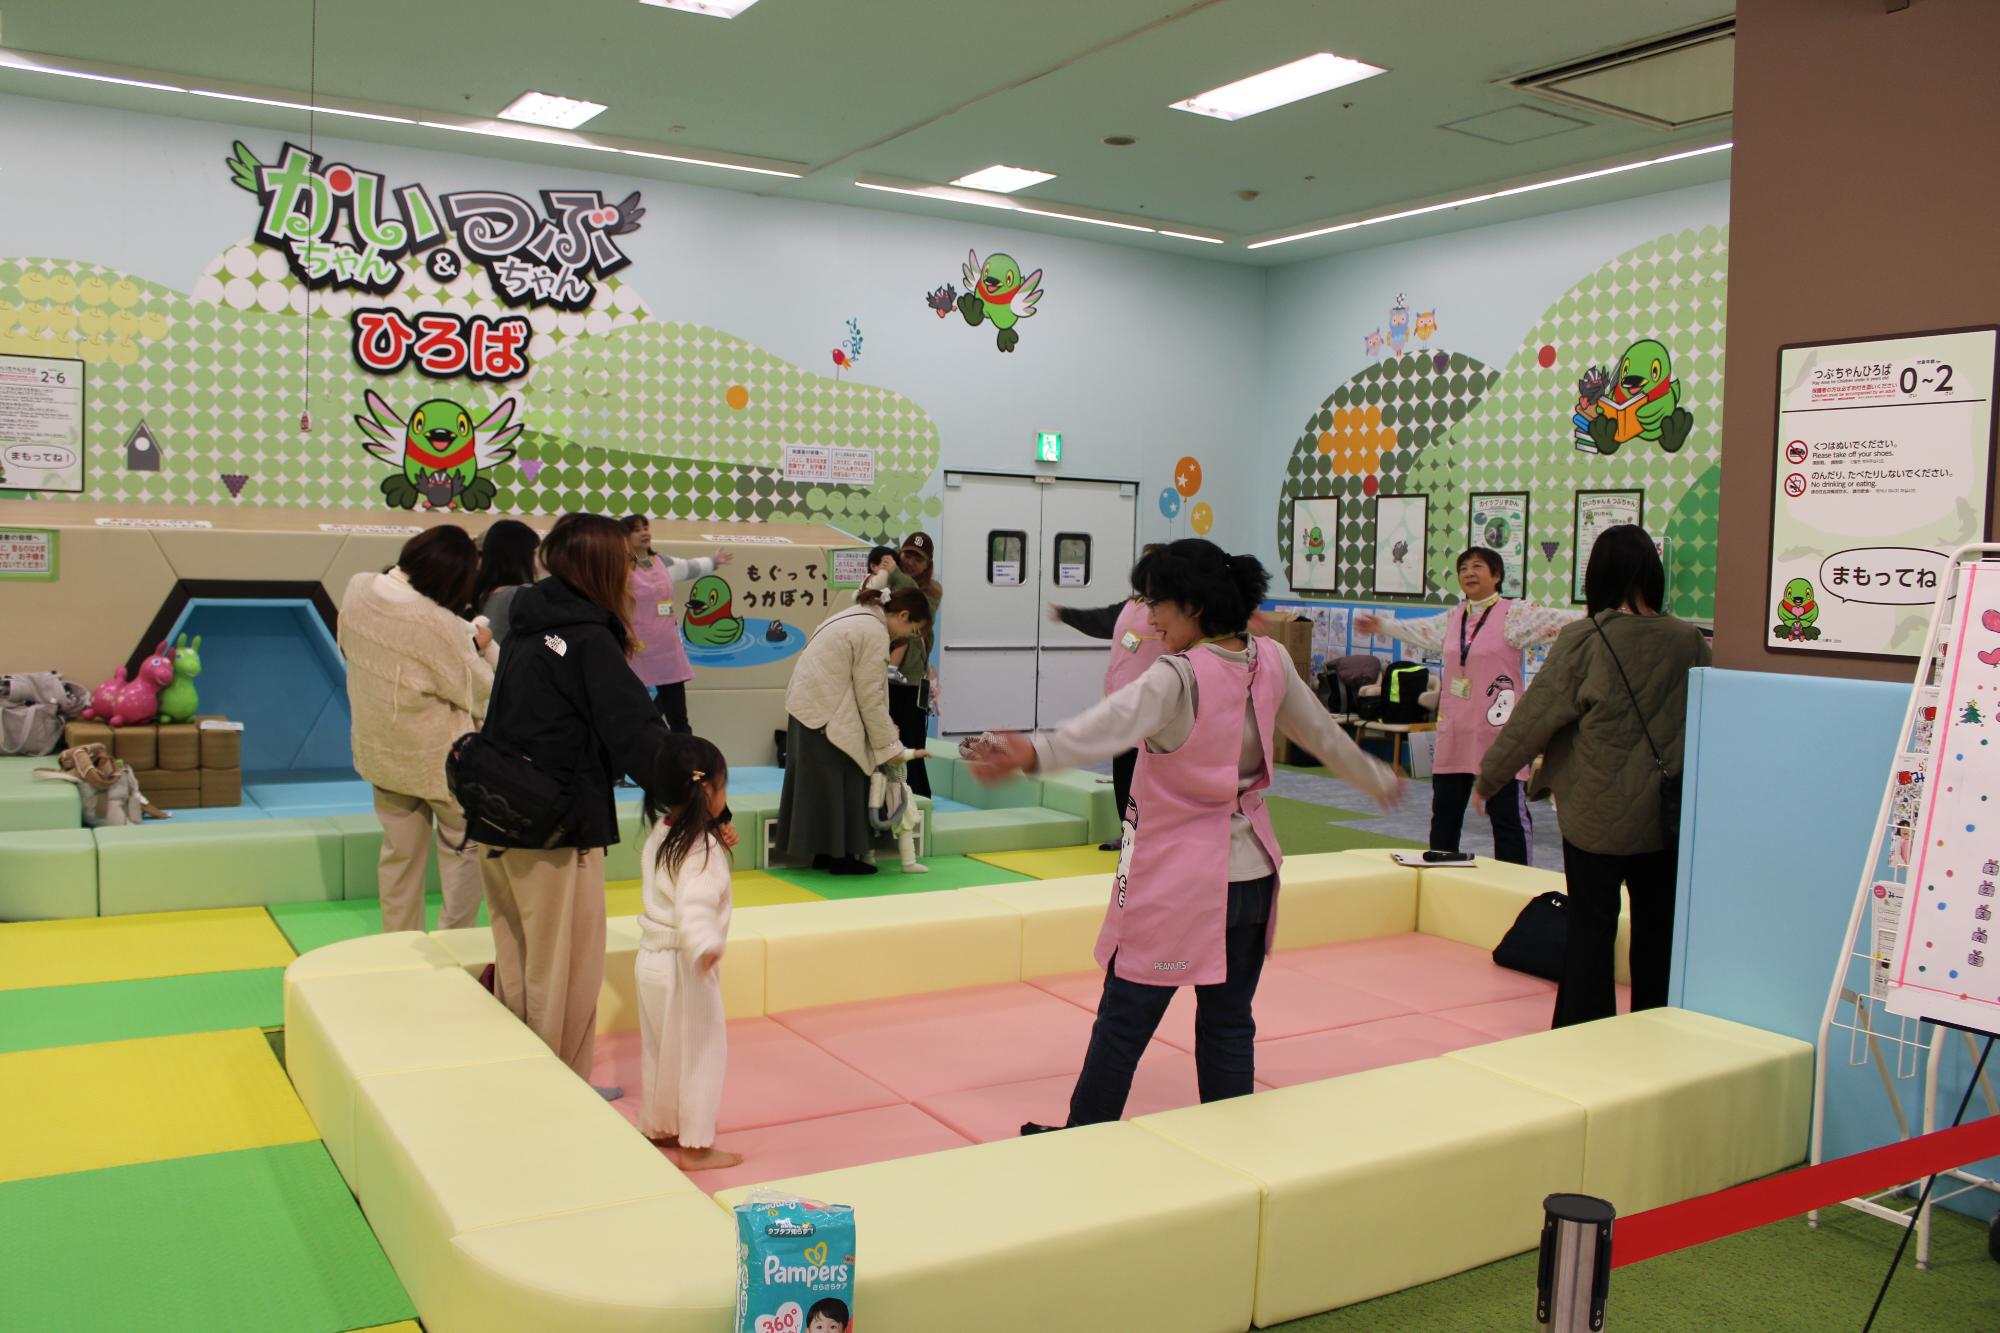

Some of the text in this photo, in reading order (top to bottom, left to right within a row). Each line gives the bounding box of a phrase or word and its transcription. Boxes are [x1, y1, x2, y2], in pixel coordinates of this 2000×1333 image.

[297, 239, 592, 303] ちゃん & ちゃん
[357, 312, 527, 377] ひろば
[1814, 363, 1893, 379] つぶちゃんひろば
[1814, 440, 1898, 450] くつはぬいでください。
[1812, 469, 1953, 480] のんだり、たべたりしないでください。
[1822, 481, 1846, 489] drinking
[746, 564, 829, 582] もぐって、
[1154, 961, 1187, 970] PEANUTS
[764, 1255, 848, 1288] Pampers
